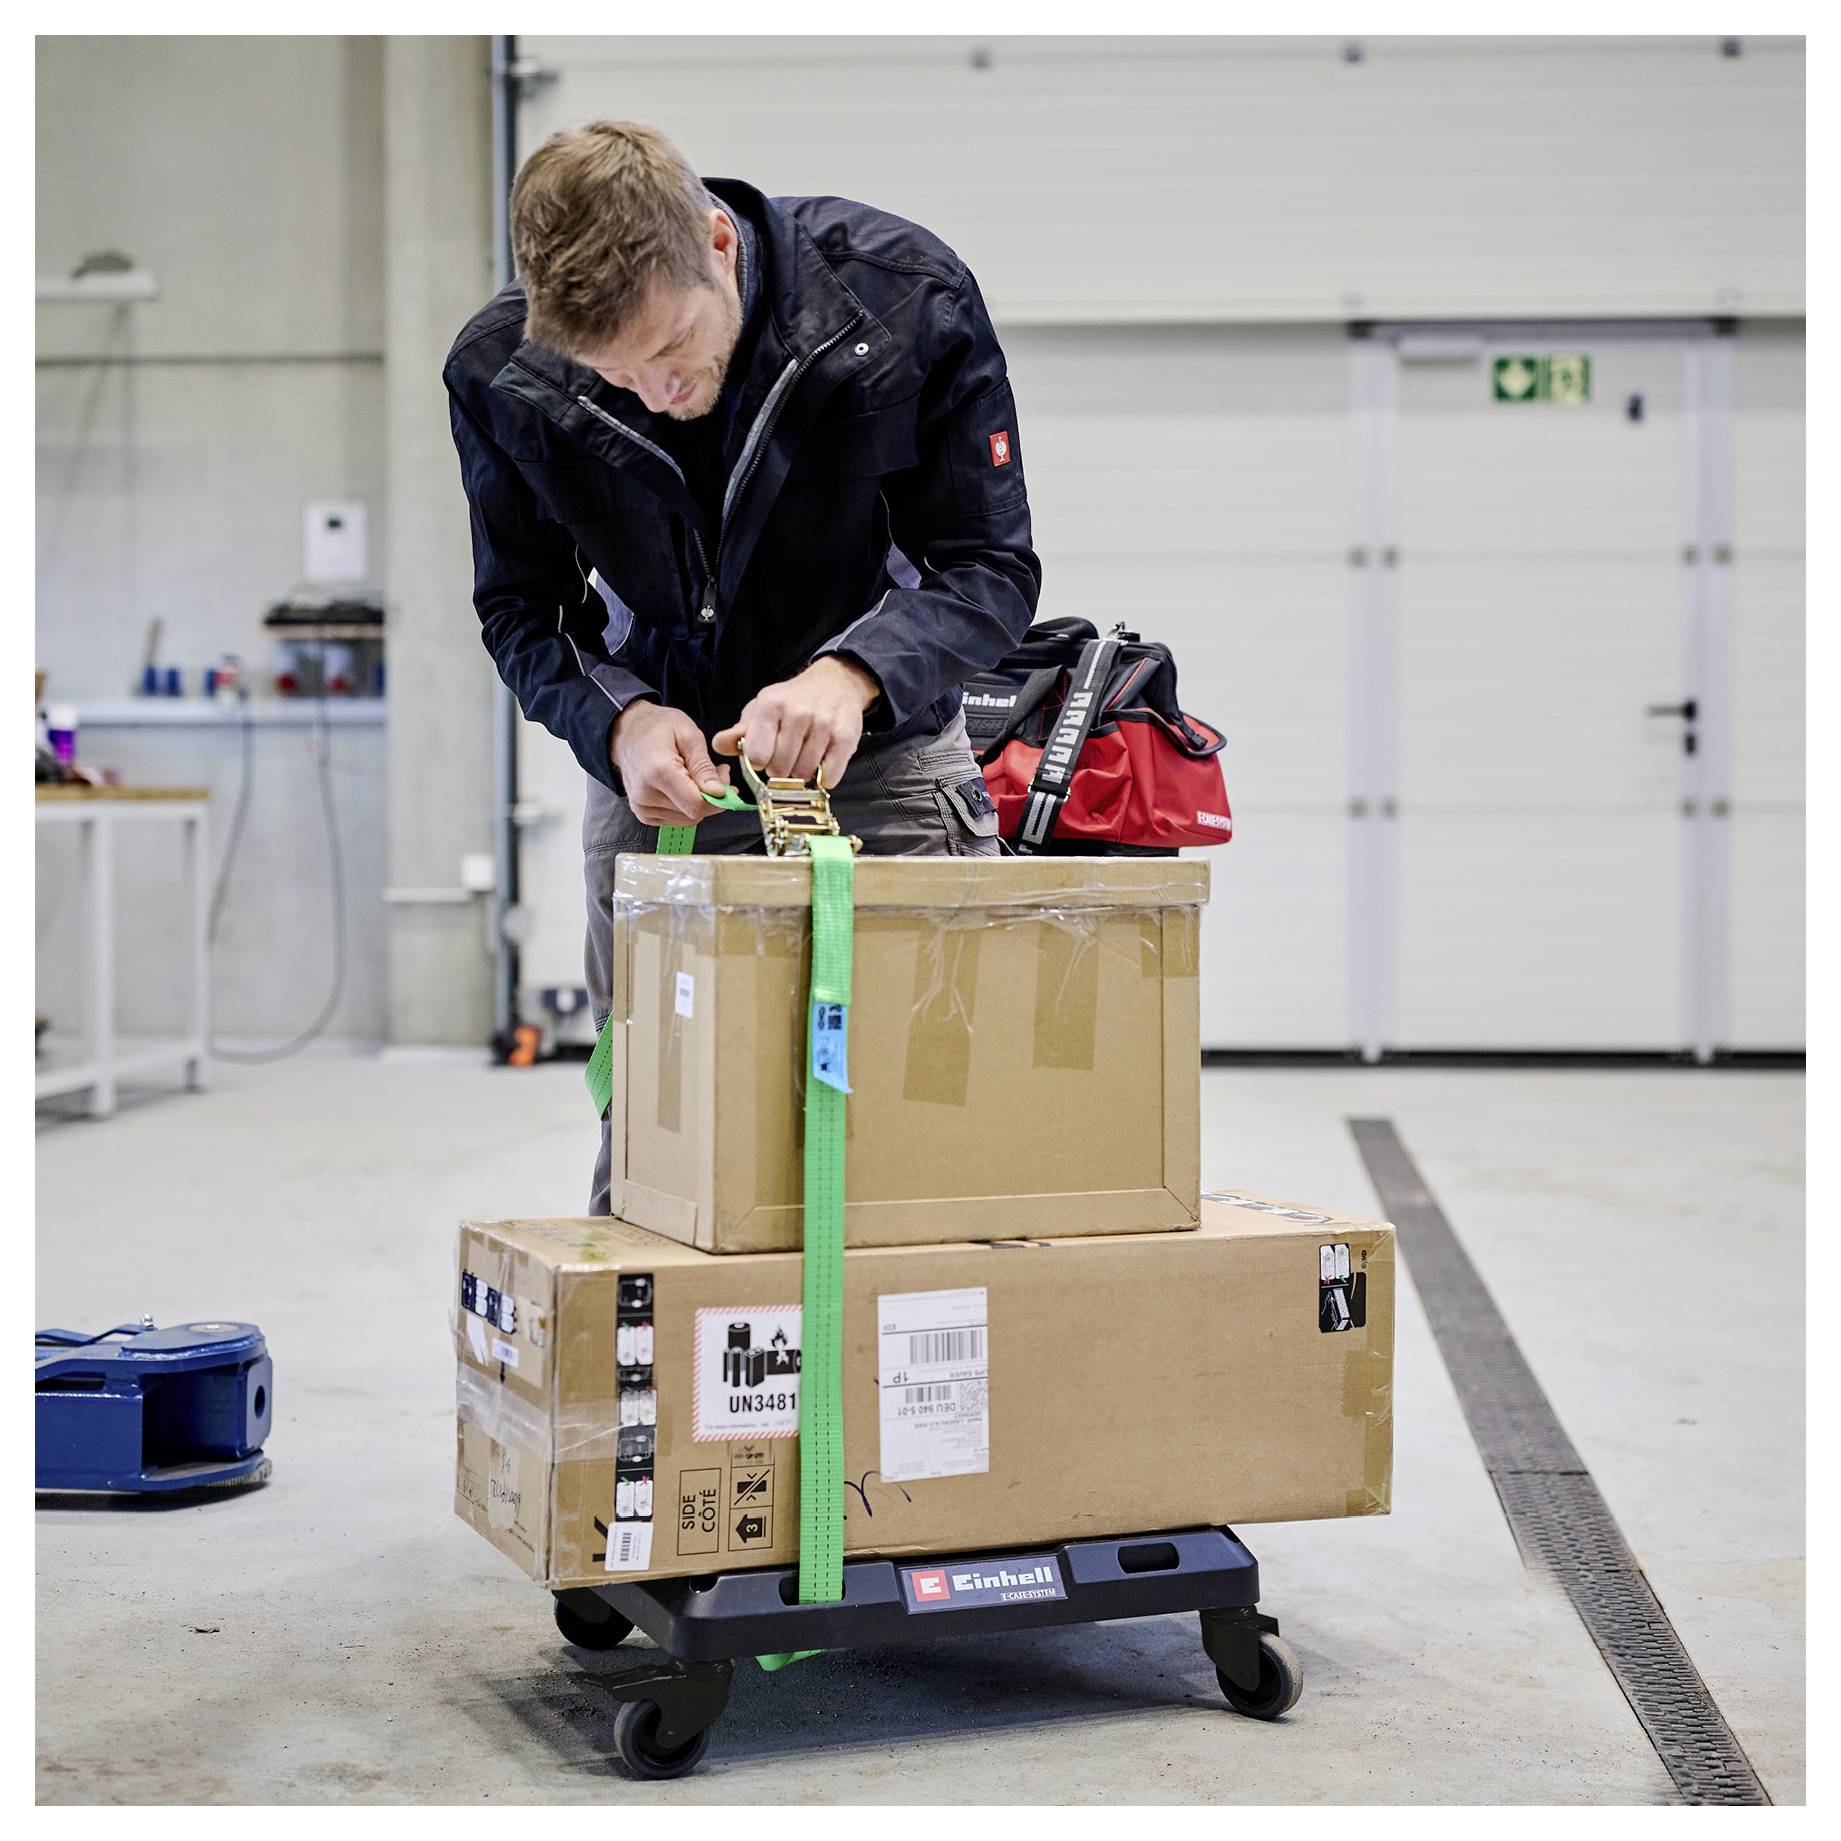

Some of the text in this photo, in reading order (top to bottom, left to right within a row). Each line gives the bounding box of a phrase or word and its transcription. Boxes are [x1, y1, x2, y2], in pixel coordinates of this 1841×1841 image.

[962, 691, 1017, 707] inhel
[892, 1371, 909, 1384] 1P
[729, 1392, 796, 1413] UN3481
[936, 1402, 956, 1414] DEU
[681, 1494, 696, 1530] SIDE
[698, 1489, 716, 1533] CÔTÉ
[746, 1523, 758, 1533] 3
[952, 1566, 1054, 1592] Einhell
